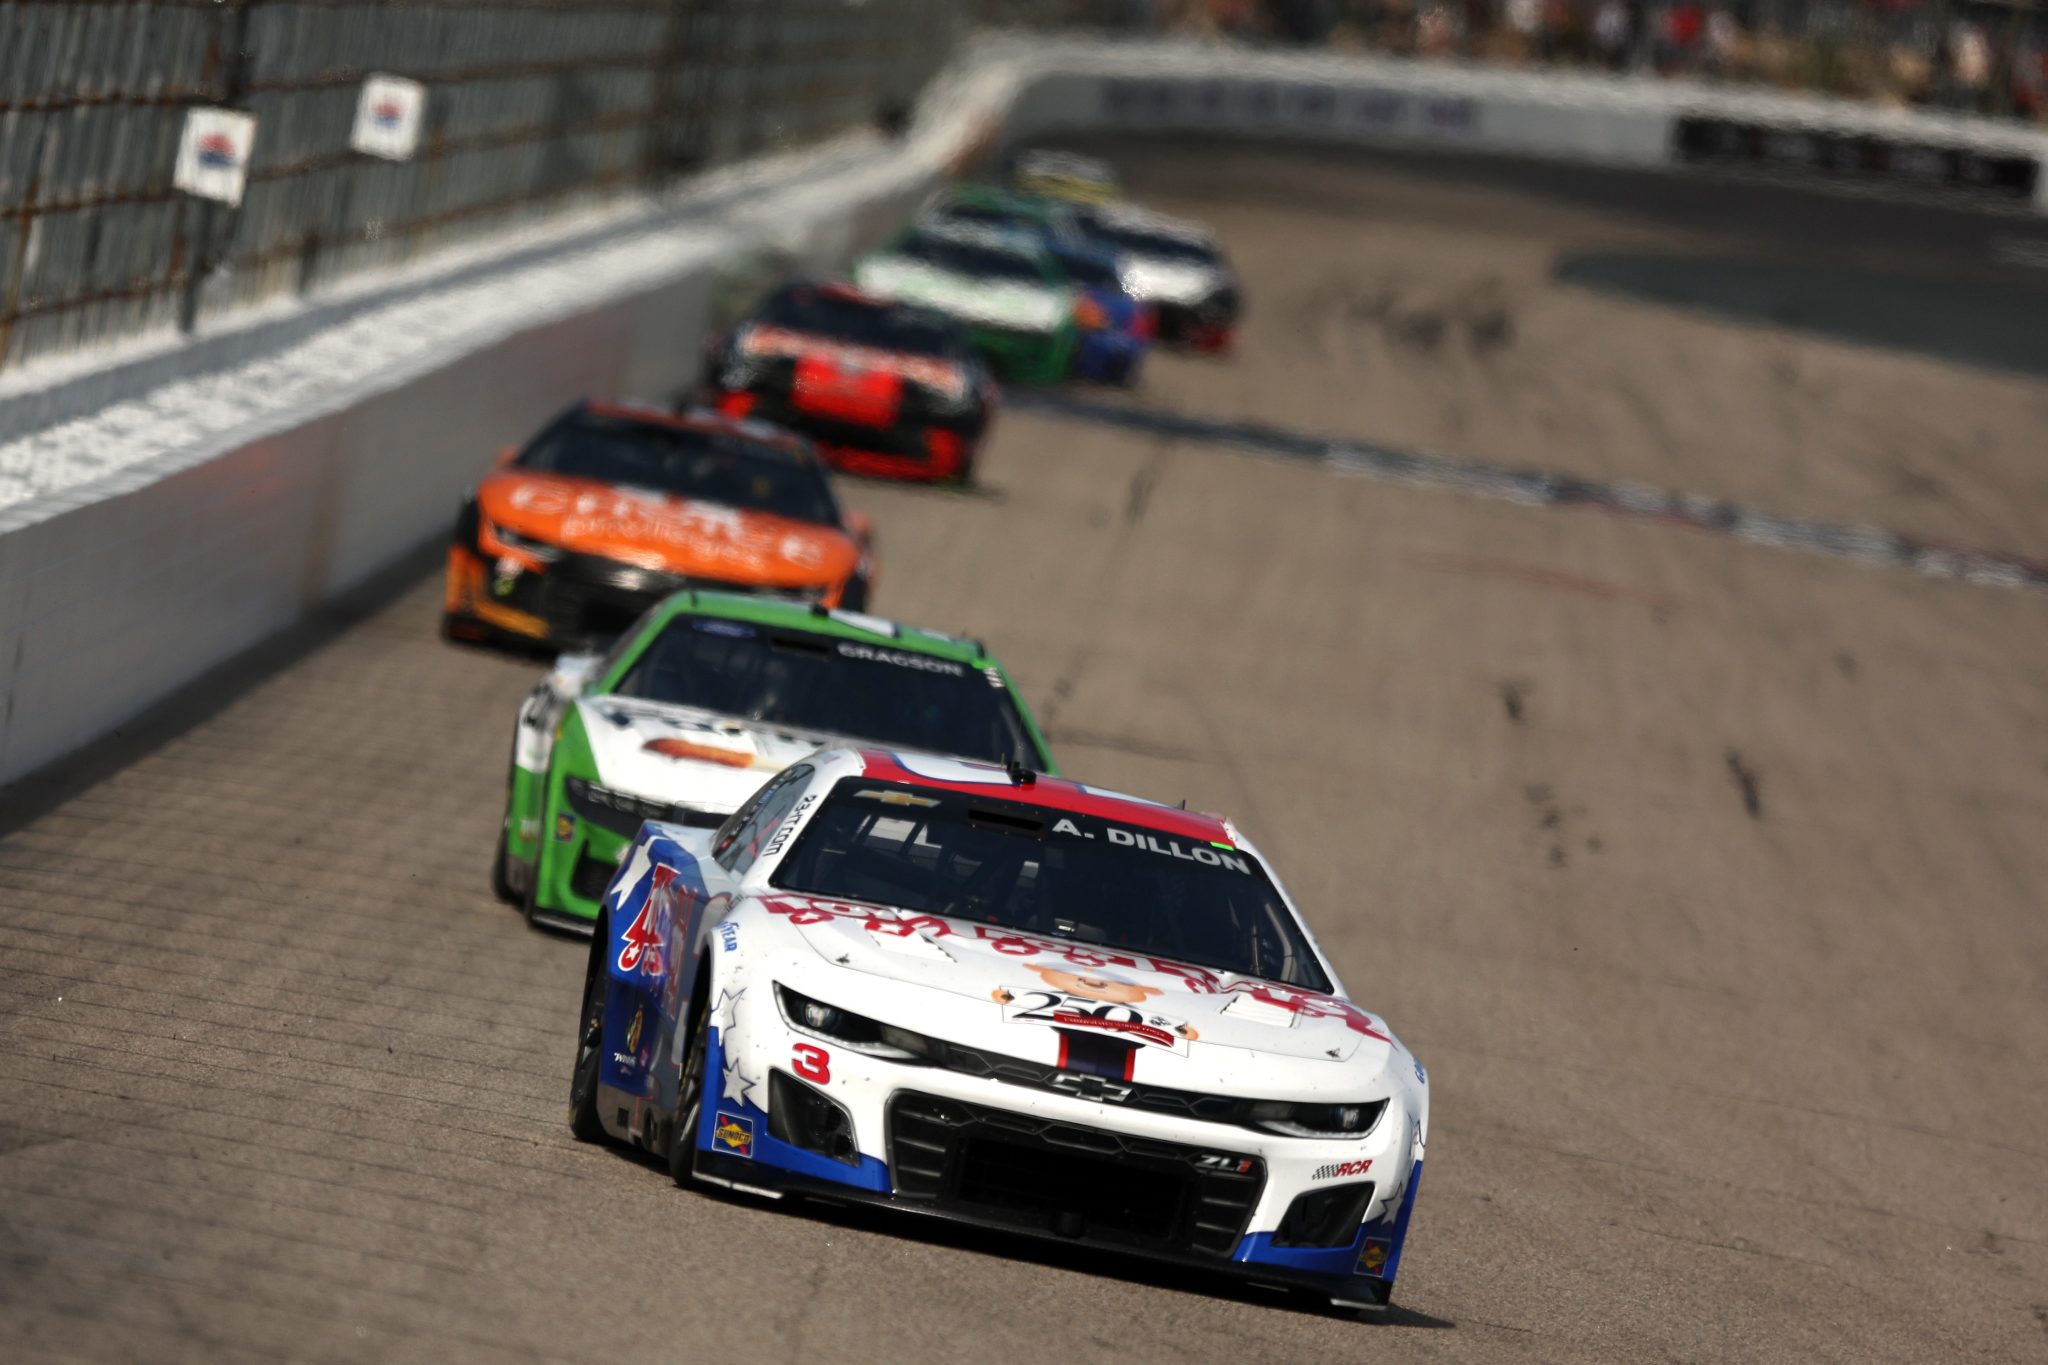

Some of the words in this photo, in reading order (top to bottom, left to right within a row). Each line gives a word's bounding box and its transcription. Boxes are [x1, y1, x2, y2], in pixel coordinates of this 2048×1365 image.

[837, 641, 965, 678] GRAGSON
[1051, 818, 1095, 840] A.
[1107, 828, 1251, 876] DILLON
[1012, 991, 1144, 1033] 250
[791, 1042, 831, 1086] 3
[715, 1127, 752, 1144] SUNOCO
[1197, 1153, 1253, 1174] ZL1
[1332, 1159, 1373, 1177] RCR
